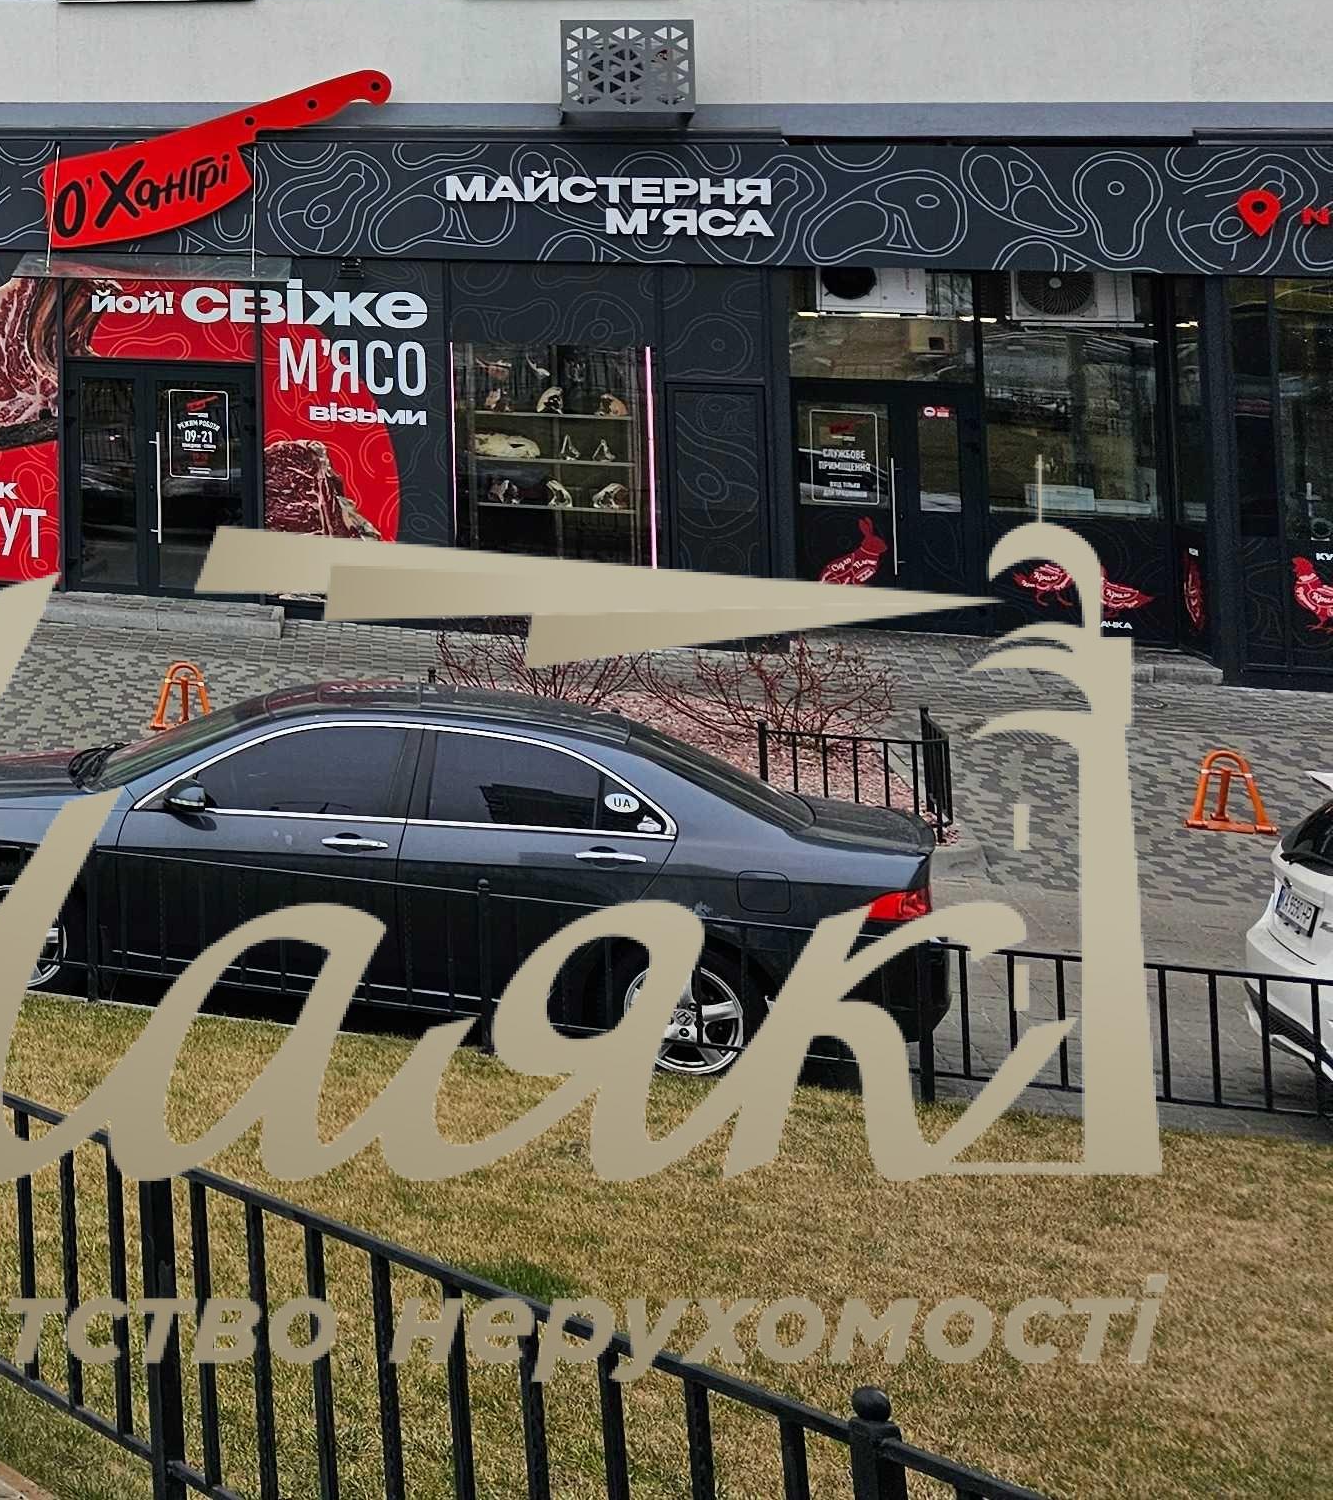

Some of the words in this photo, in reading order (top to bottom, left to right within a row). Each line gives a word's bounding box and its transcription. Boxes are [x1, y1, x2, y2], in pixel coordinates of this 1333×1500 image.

[445, 170, 772, 205] МАЙСТЕРНЯ
[605, 207, 775, 237] М'ЯСА
[91, 289, 174, 315] йой!
[181, 278, 429, 329] свіже
[279, 337, 428, 398] М'ЯСО
[308, 402, 428, 426] візьми
[184, 429, 213, 443] 09-21
[613, 797, 631, 809] UA
